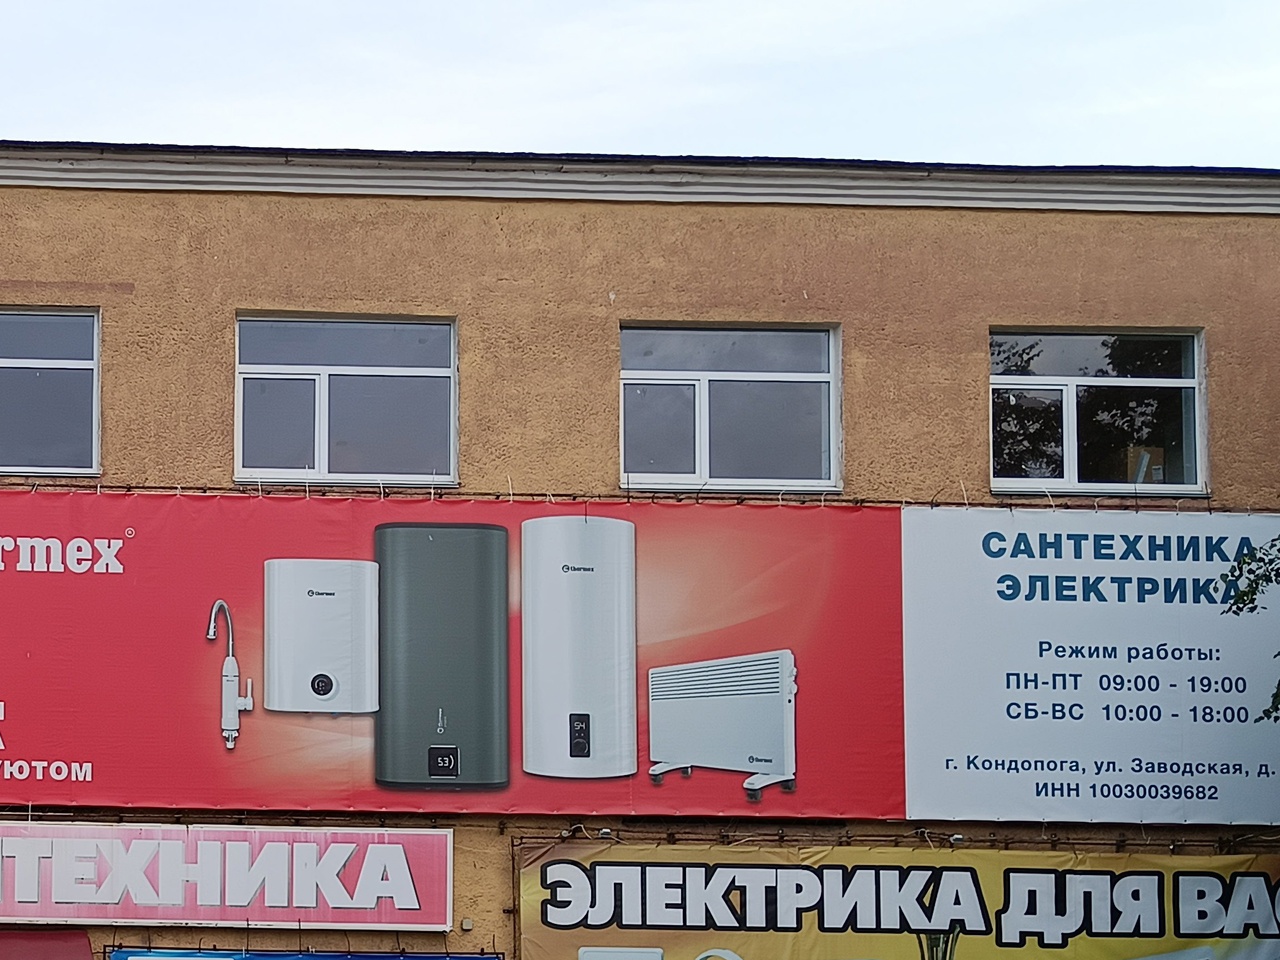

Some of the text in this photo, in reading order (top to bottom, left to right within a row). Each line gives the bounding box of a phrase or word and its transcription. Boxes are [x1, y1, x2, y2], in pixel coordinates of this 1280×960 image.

[982, 532, 1257, 562] САНТЕХНИКА
[996, 574, 1244, 605] ЭЛЕКТРИКА
[1039, 641, 1221, 663] Режим работы:
[1006, 672, 1083, 691] ПН-ПТ
[1099, 674, 1160, 692] 09:00
[1187, 676, 1247, 693] 19:00
[1006, 702, 1084, 721] СБ-ВС
[1102, 704, 1162, 722] 10:00
[1189, 706, 1249, 723] 18:00
[945, 755, 1277, 778] г. Кондопога, ул. Заводская, д.
[1035, 782, 1218, 800] ИНН 10030039682
[546, 864, 1280, 945] ЭЛЕКТРИКА ДЛЯ ВА
